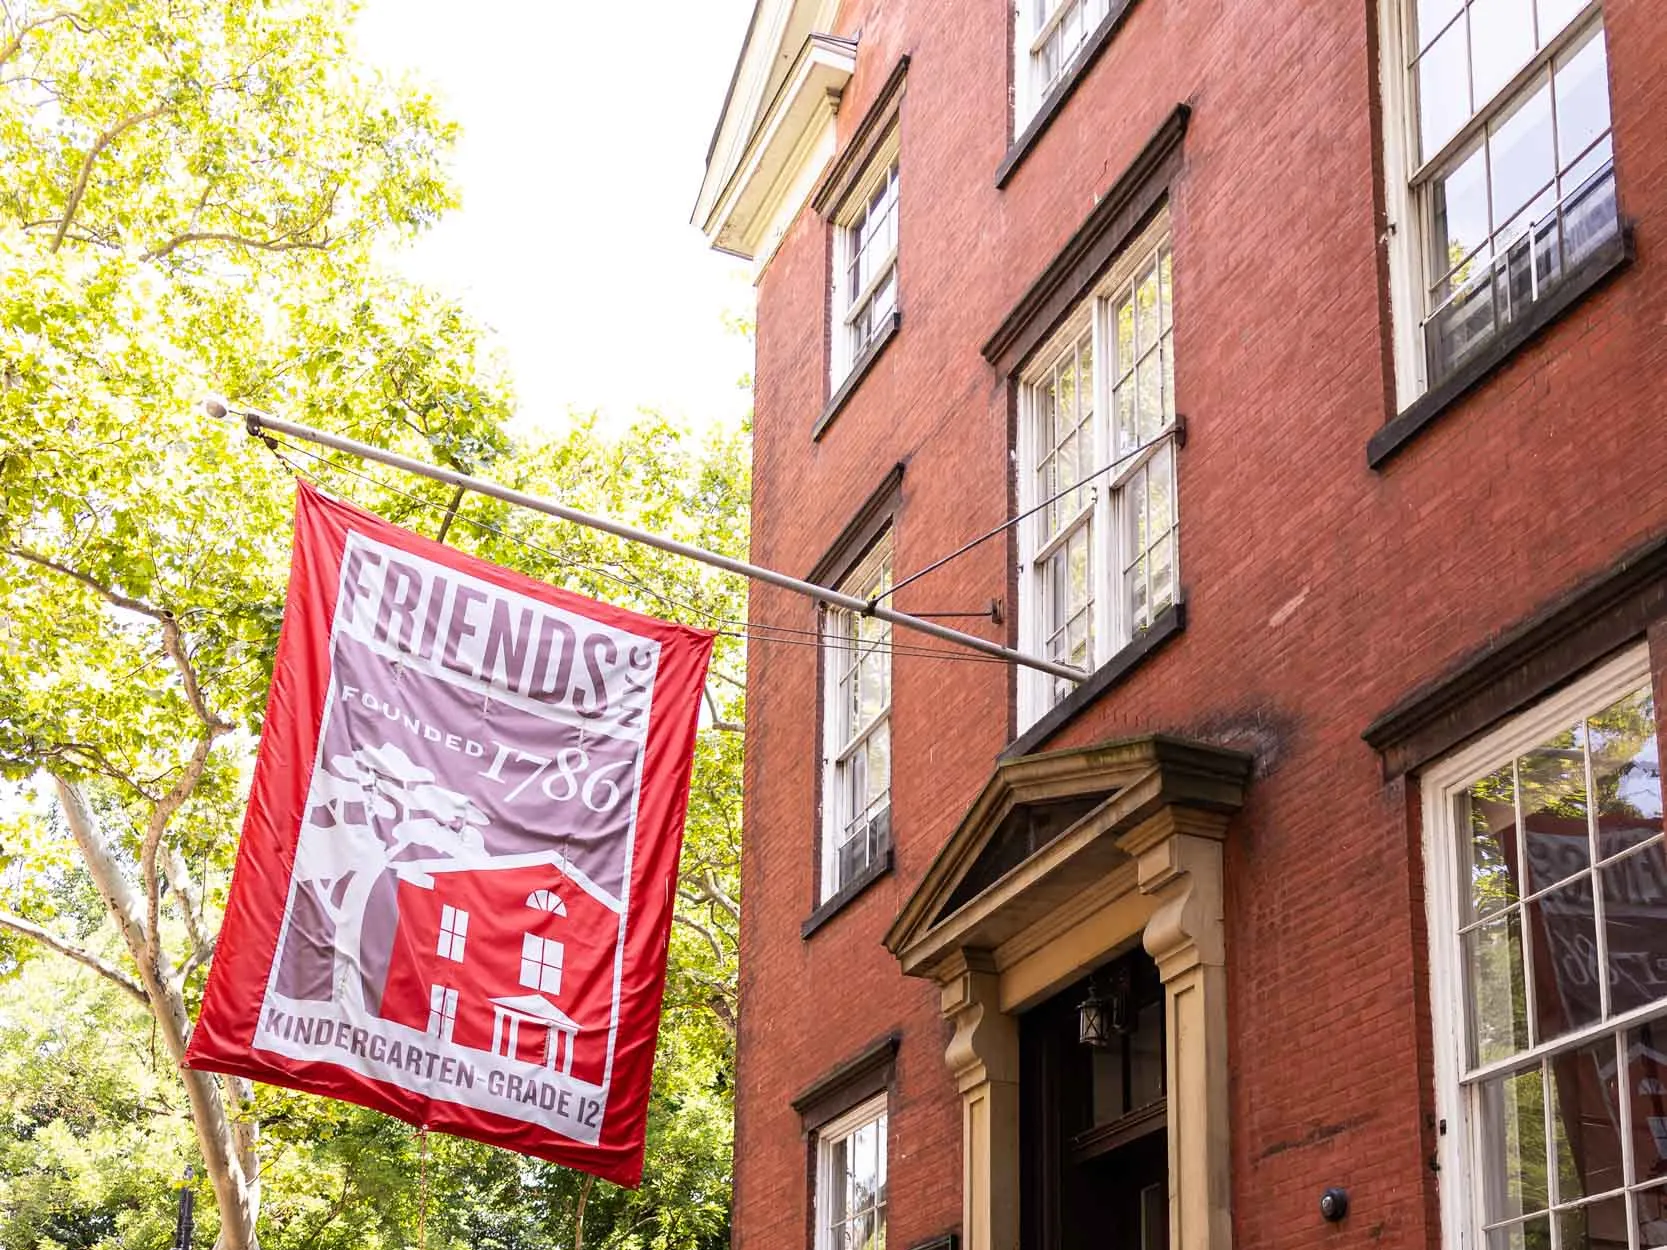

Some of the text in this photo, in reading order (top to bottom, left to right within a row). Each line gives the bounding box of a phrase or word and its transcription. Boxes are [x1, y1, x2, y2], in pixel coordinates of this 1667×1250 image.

[341, 549, 617, 719] FRIENDS
[617, 645, 652, 728] NYC
[342, 685, 633, 812] FOUNDED 1786
[264, 1007, 600, 1128] KINDERGARTEN-GRADE 12
